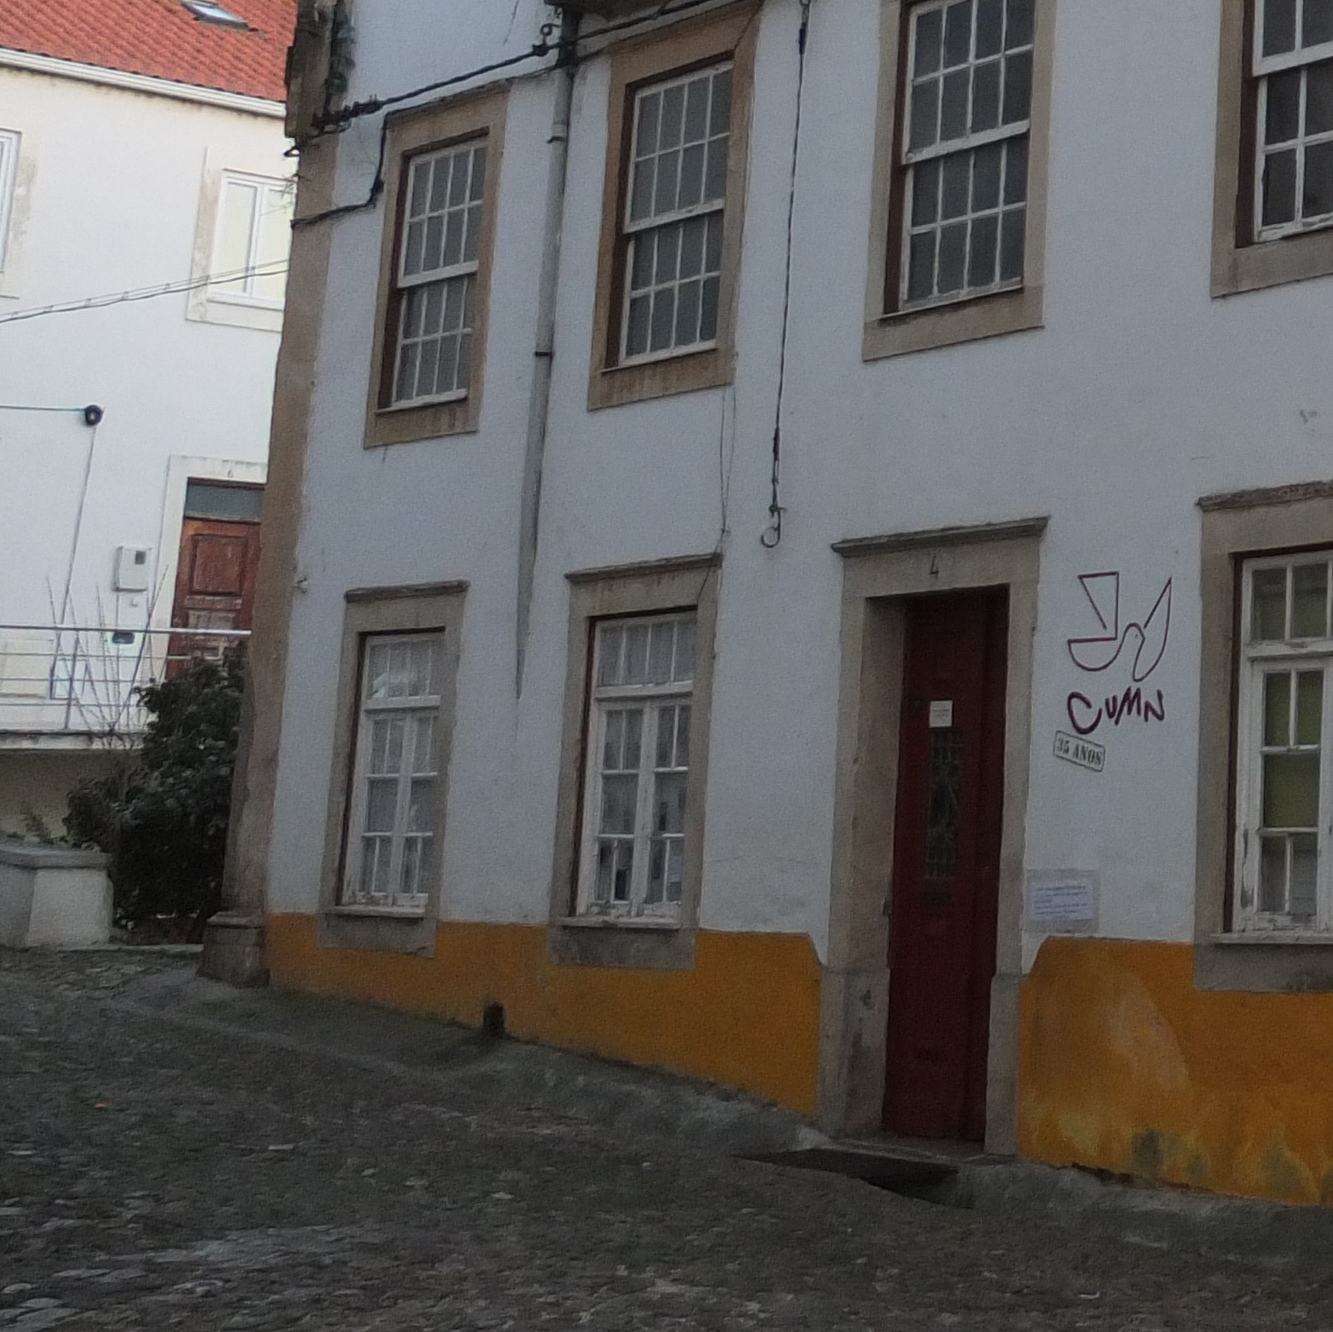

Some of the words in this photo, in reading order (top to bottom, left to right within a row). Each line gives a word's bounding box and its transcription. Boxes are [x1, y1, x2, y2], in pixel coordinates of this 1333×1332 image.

[929, 554, 940, 579] 4
[1056, 737, 1070, 755] 35
[1072, 743, 1103, 766] ANOS
